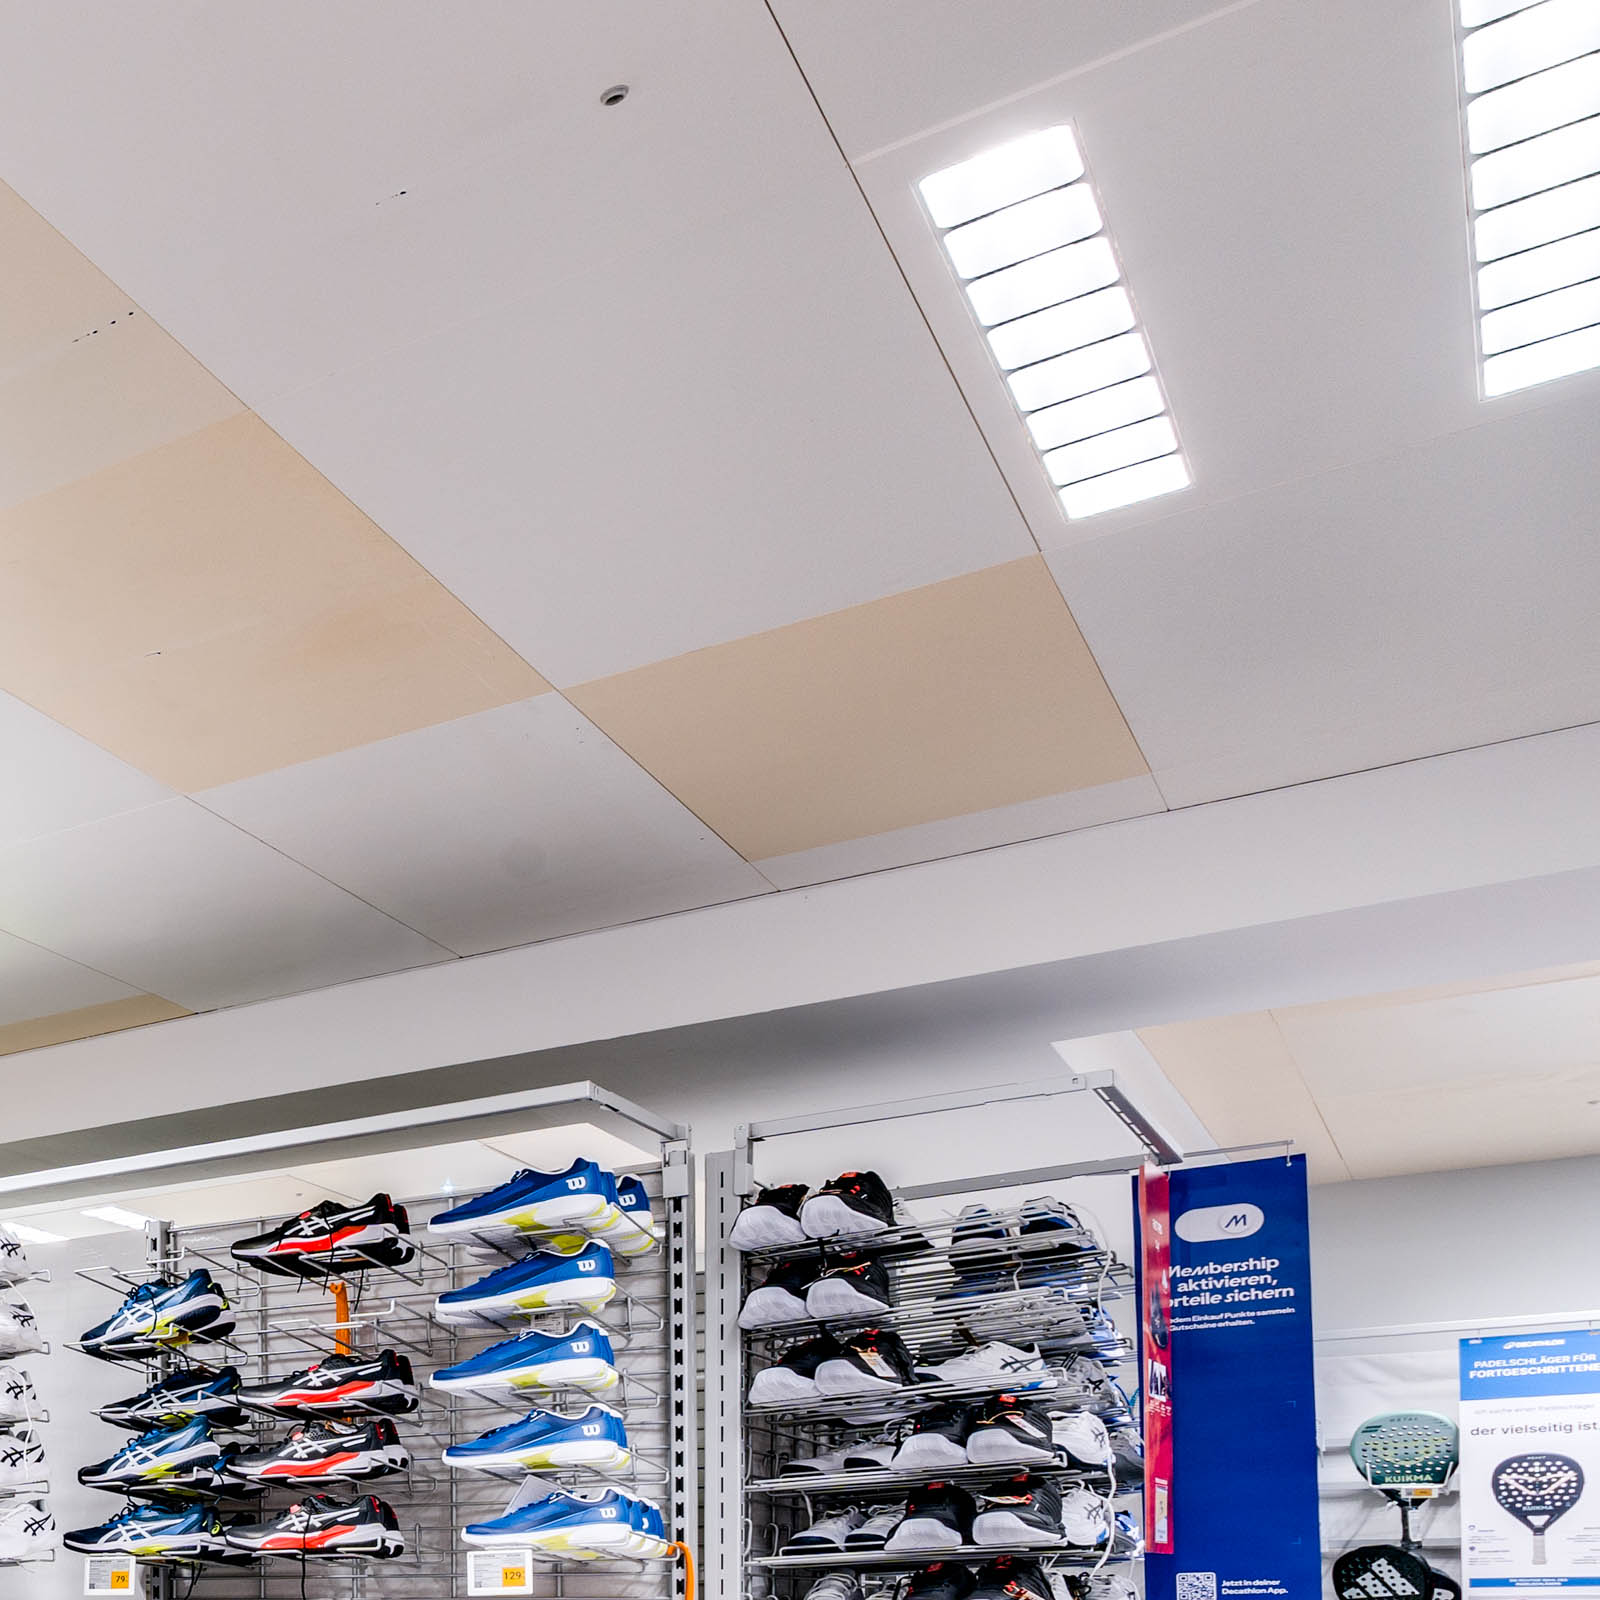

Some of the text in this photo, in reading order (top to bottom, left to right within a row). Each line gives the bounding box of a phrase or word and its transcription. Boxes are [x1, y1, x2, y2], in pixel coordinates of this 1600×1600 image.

[1177, 1275, 1278, 1292] aktivieren,
[1224, 1287, 1294, 1303] sichern
[1192, 1313, 1224, 1322] Einkauf
[1224, 1310, 1255, 1319] Punkte
[1474, 1353, 1597, 1369] PADELSCHLÄGER FÜR
[1470, 1427, 1496, 1436] der
[1501, 1422, 1573, 1434] vielseitig
[1384, 1474, 1433, 1484] KUIKMA
[504, 1571, 522, 1580] 129
